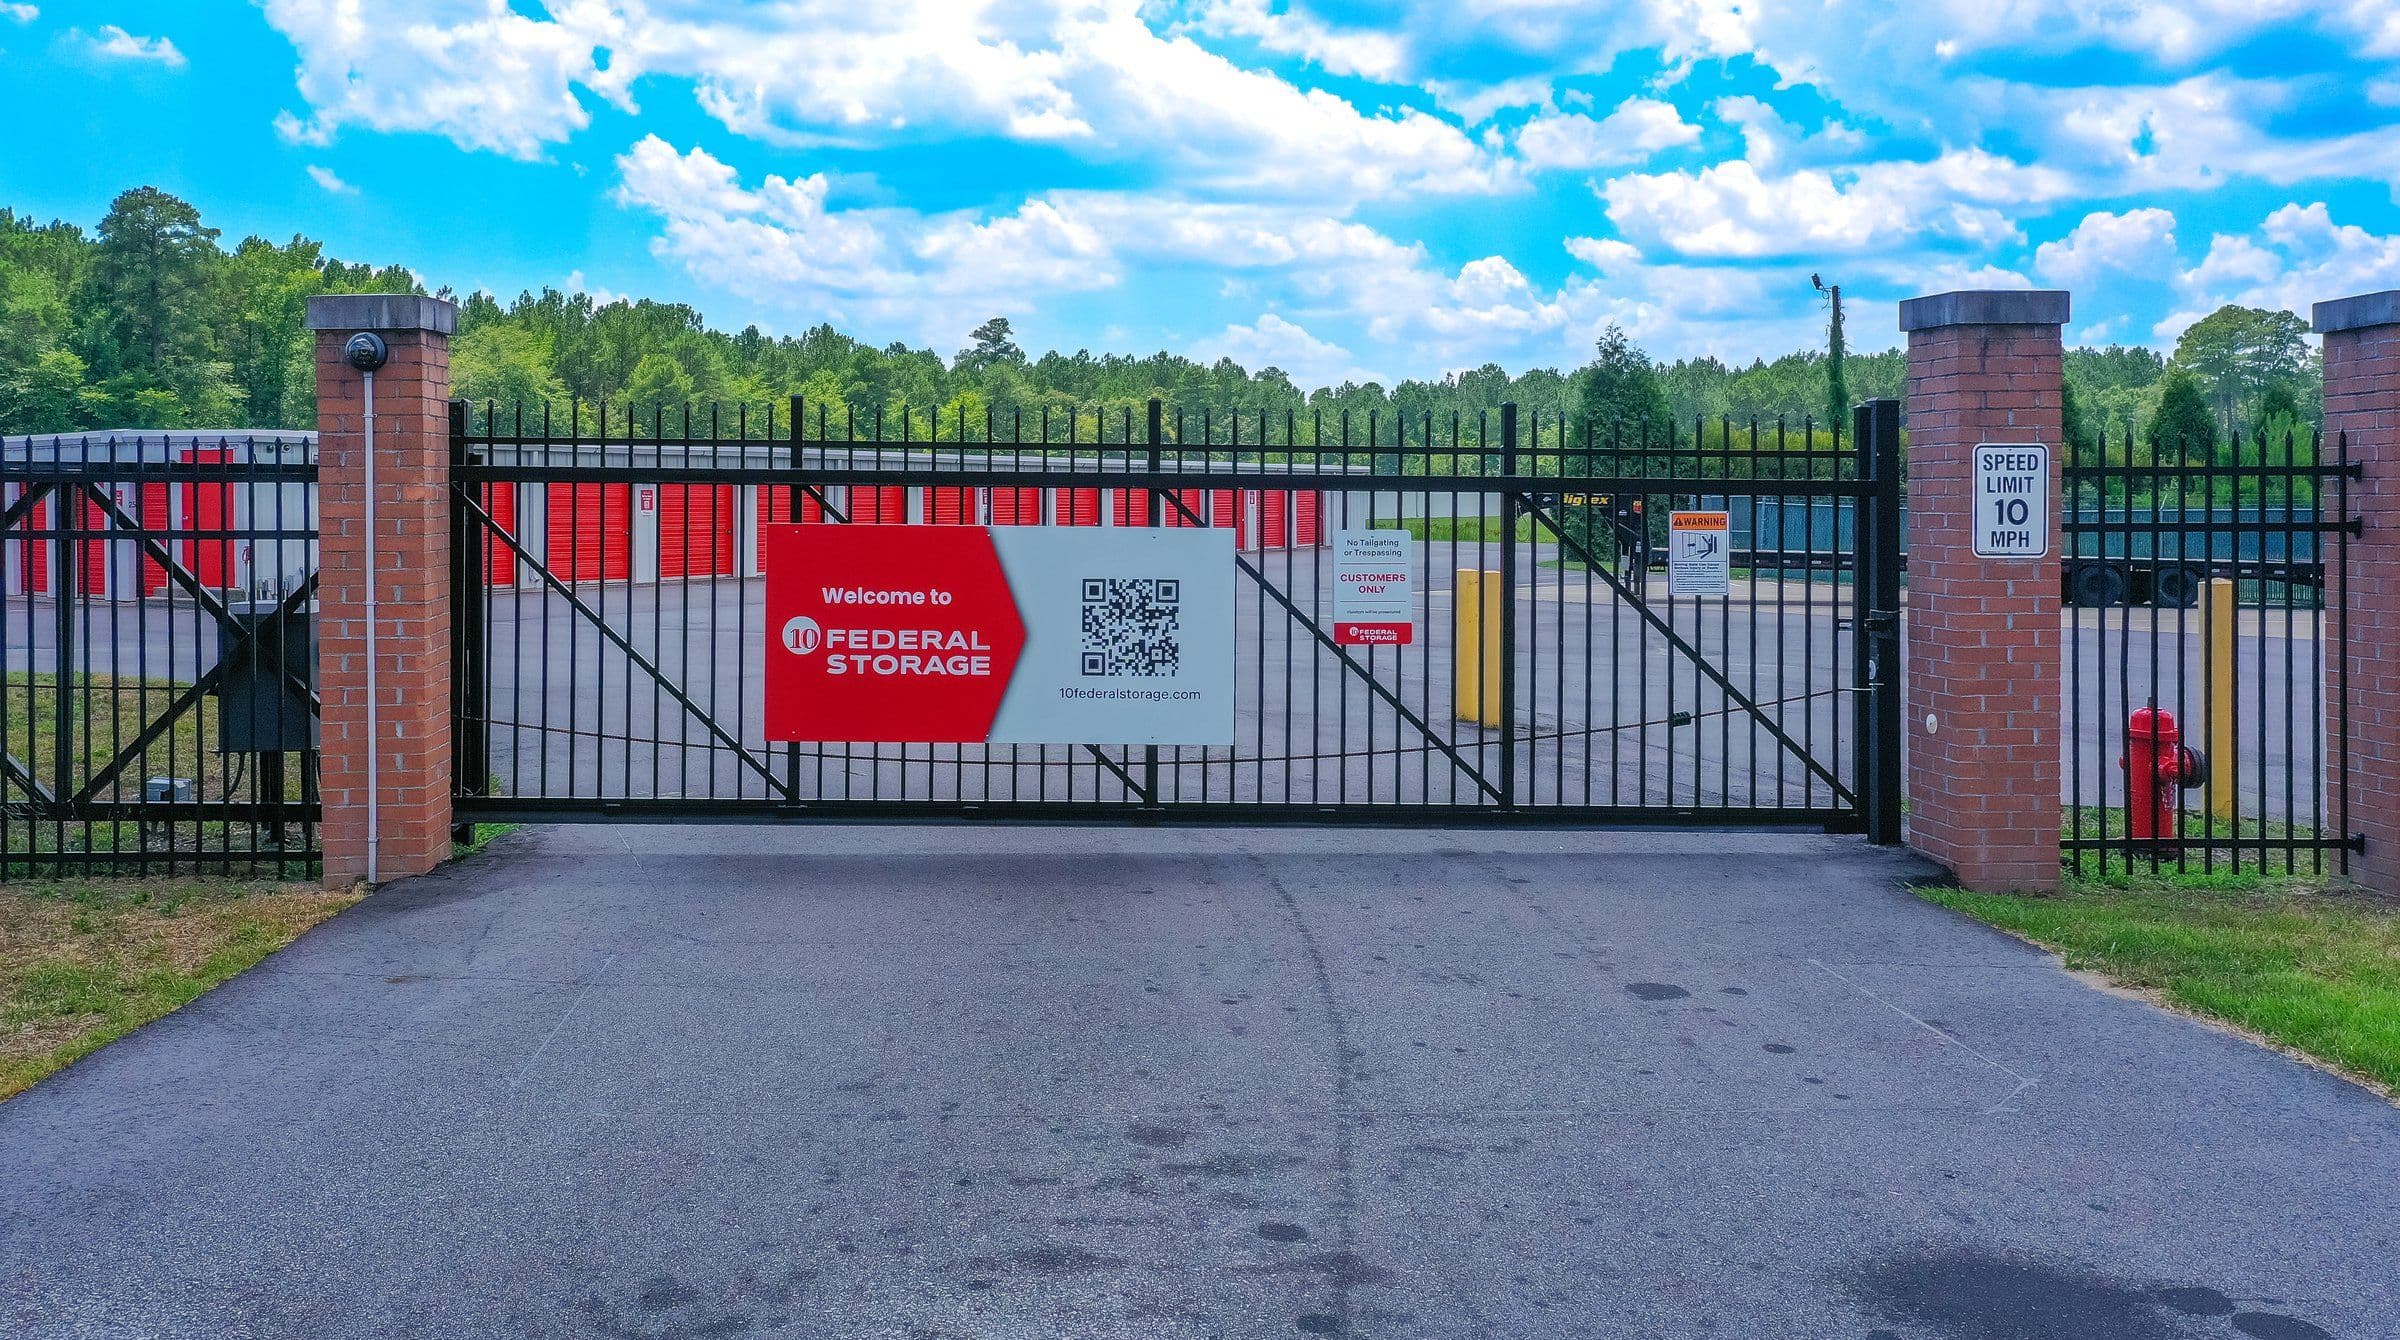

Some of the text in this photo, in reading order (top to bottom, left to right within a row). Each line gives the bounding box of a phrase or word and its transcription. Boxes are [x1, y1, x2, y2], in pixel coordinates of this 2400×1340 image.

[1983, 454, 2038, 471] SPEED
[1986, 477, 2034, 494] LIMIT
[1995, 498, 2028, 526] 10
[1683, 517, 1726, 527] WARNING
[1360, 539, 1399, 547] Tailgating
[1991, 531, 2030, 548] MPH
[1354, 549, 1402, 557] Trespassing
[1340, 574, 1406, 582] CUSTOMERS
[822, 587, 952, 606] Welcome to
[1358, 585, 1386, 594] ONLY
[788, 628, 990, 650] 10 FEDERAL
[827, 655, 991, 675] STORAGE
[1059, 687, 1201, 702] 10federalstorage.com
